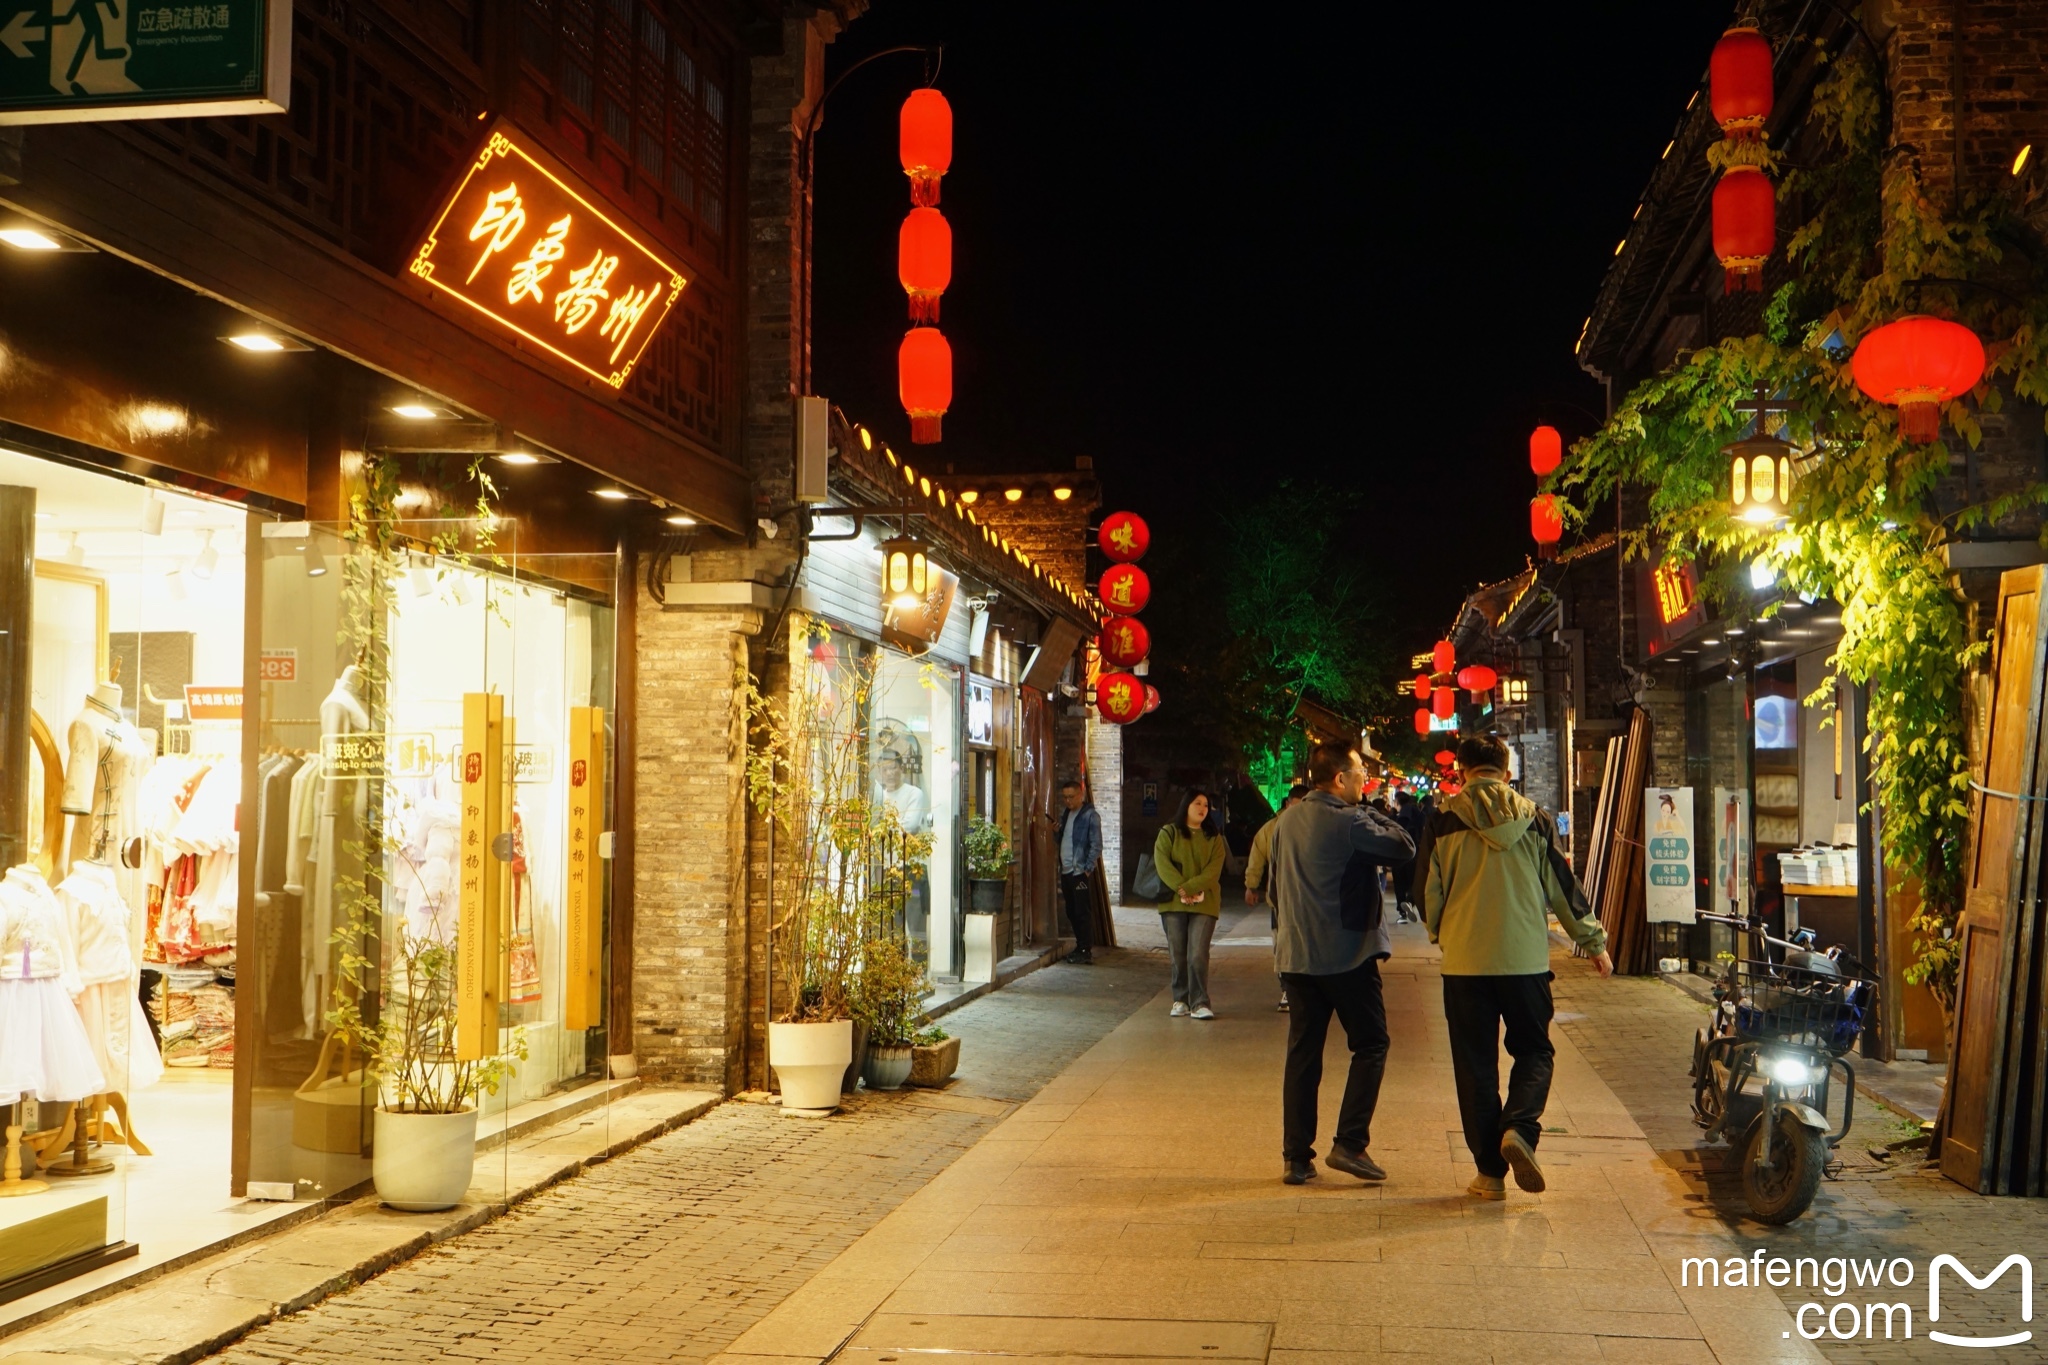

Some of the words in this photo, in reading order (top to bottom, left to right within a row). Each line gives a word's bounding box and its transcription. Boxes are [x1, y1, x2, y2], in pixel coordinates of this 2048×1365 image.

[136, 37, 178, 46] Emergency
[180, 34, 223, 44] Evacuation
[137, 4, 230, 32] 应急疏散通
[466, 805, 479, 893] 印象扬州
[572, 806, 585, 883] 印象扬州
[466, 900, 476, 1000] YINXIANGYANGZHOU
[573, 890, 582, 977] YINXIANGYANGZHOU
